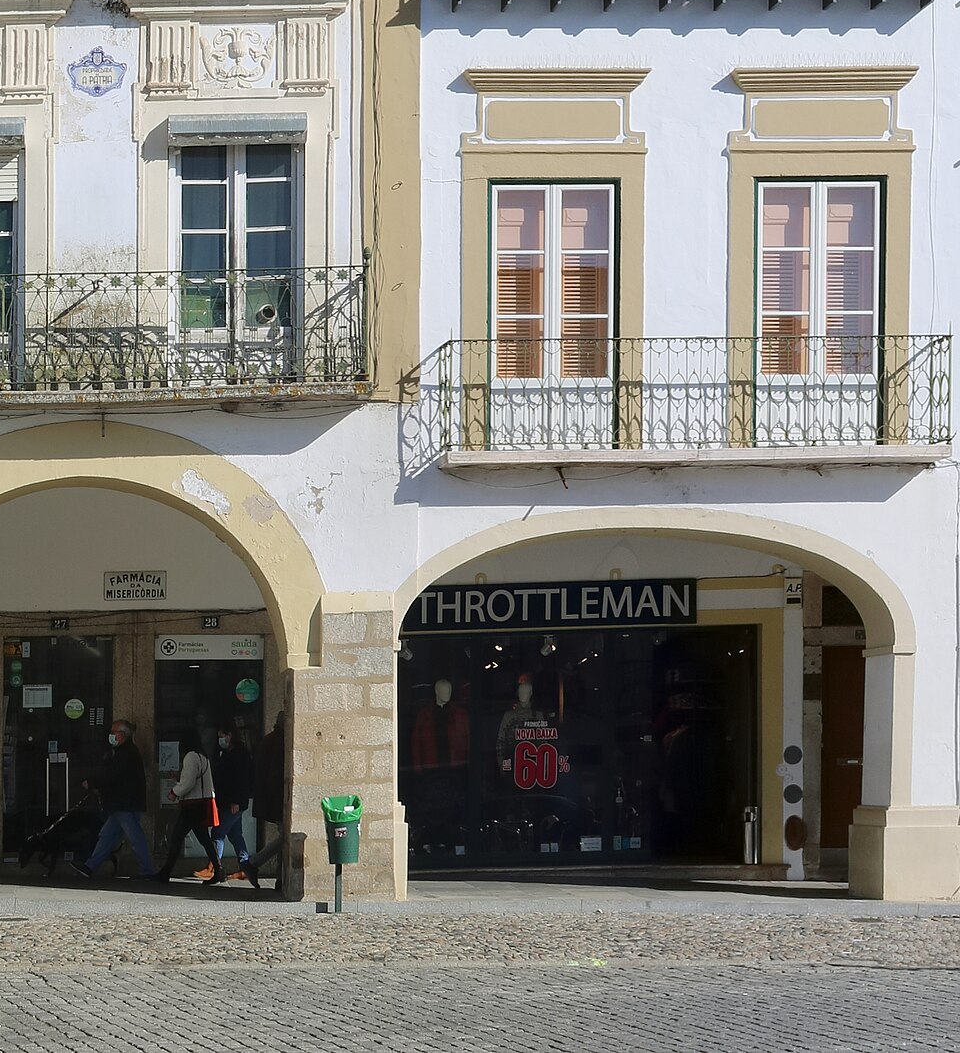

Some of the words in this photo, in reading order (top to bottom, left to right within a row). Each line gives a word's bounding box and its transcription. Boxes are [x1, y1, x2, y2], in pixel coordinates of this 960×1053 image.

[82, 76, 87, 84] A
[110, 572, 161, 586] FARMÁCIA
[106, 588, 164, 598] MISERICÓRDIA
[419, 584, 690, 625] THROTTLEMAN
[54, 619, 67, 628] 27
[205, 617, 218, 627] 28
[515, 728, 535, 740] NOVA
[536, 727, 558, 739] BAIXA
